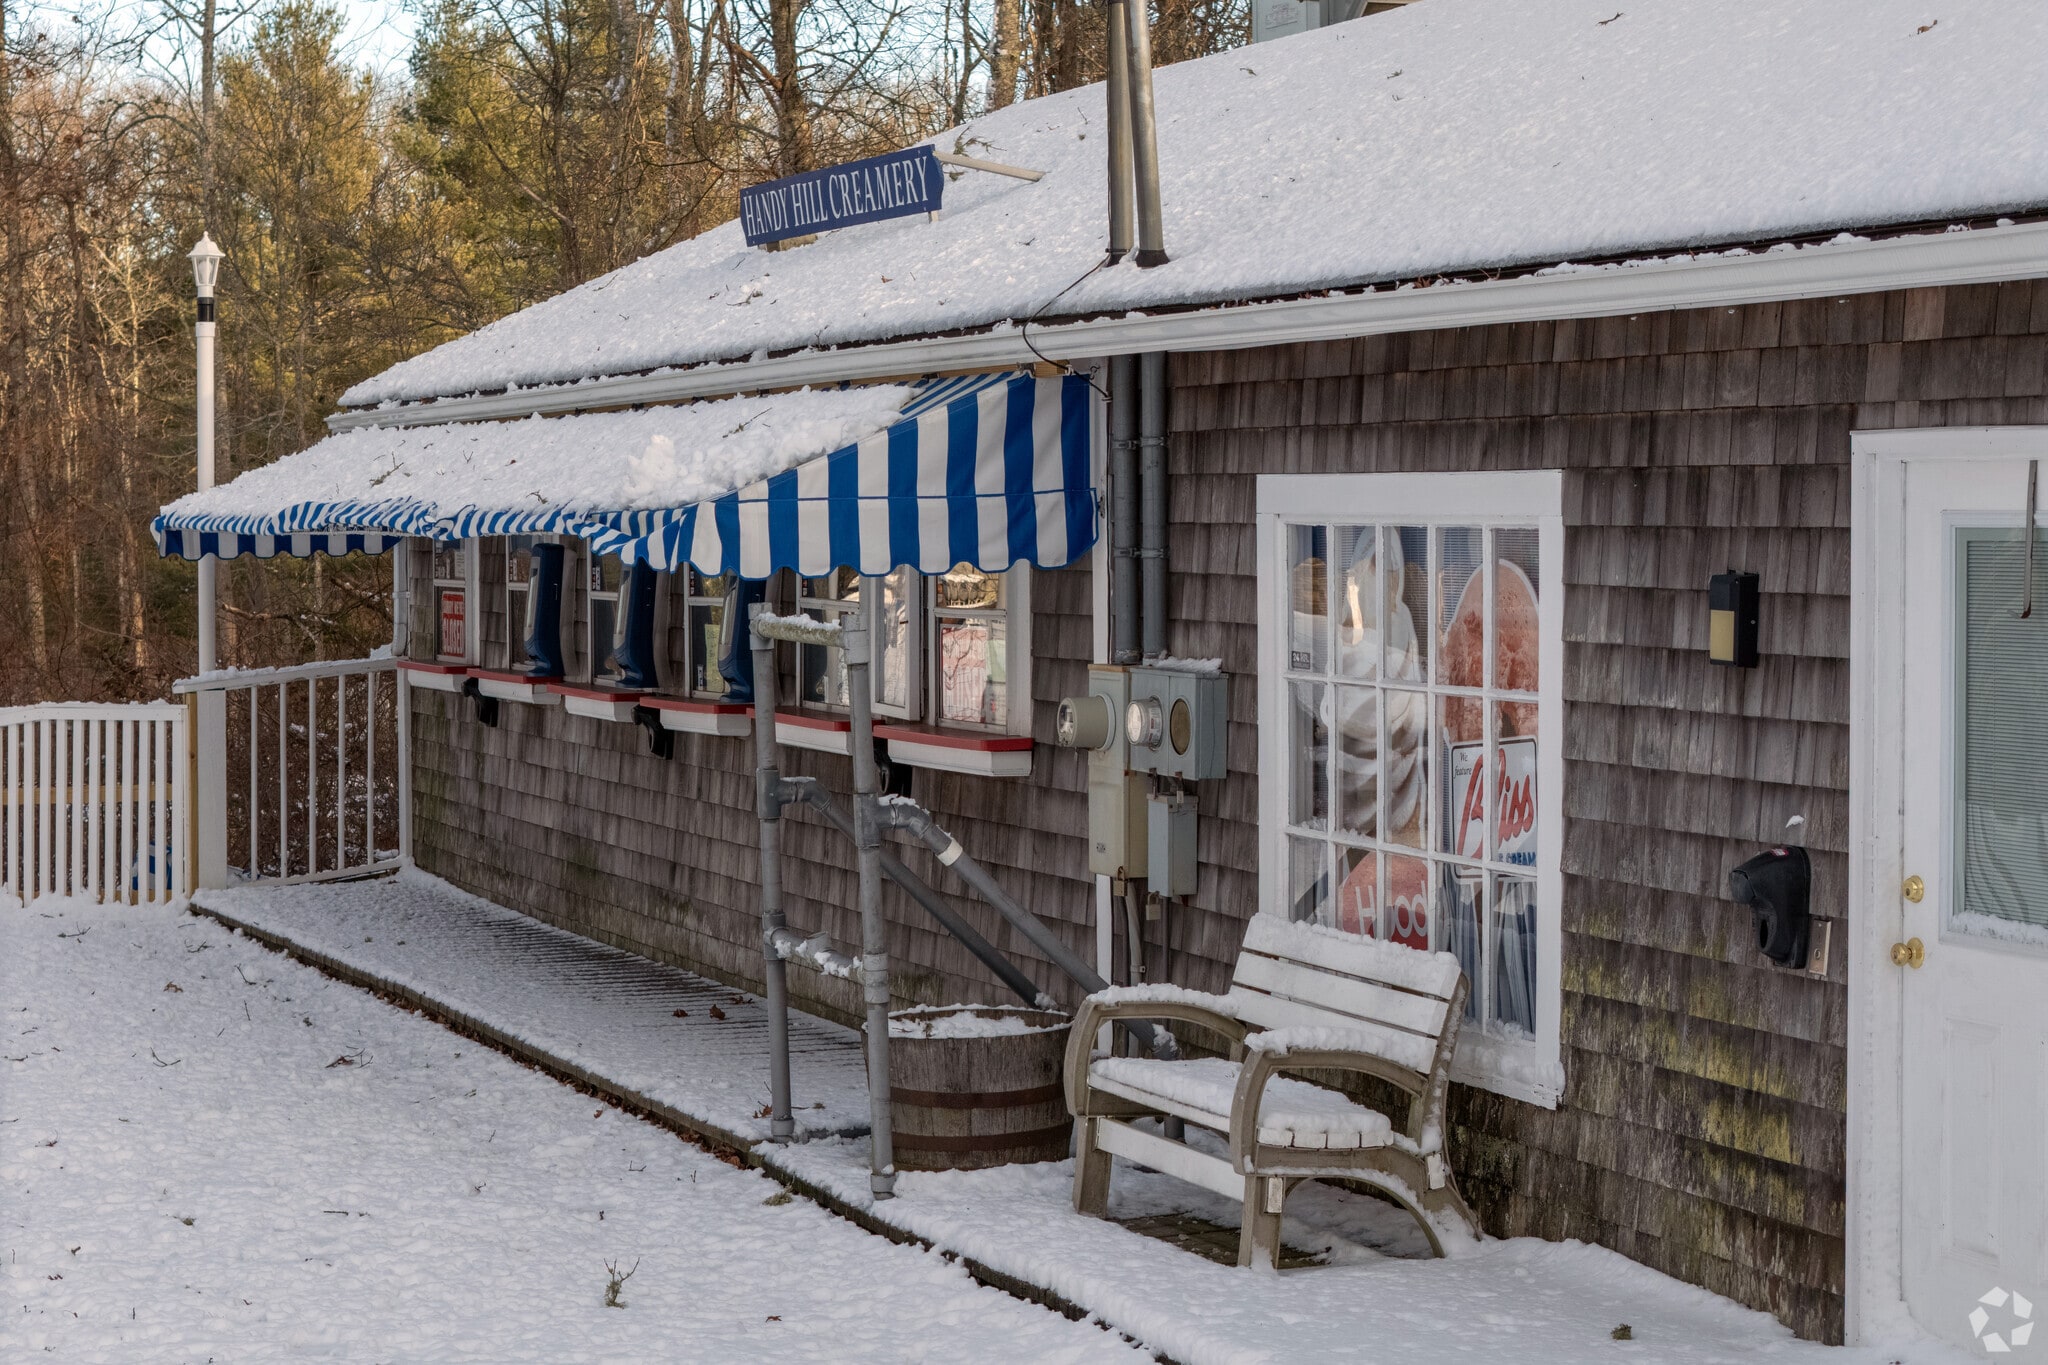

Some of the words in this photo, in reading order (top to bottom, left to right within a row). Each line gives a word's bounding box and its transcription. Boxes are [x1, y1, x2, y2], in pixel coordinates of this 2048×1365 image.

[743, 187, 790, 237] HANDY
[790, 179, 829, 227] HILL
[828, 156, 929, 219] CREAMERY
[1453, 765, 1473, 779] feature
[1460, 752, 1468, 762] We
[1355, 880, 1428, 940] Hod
